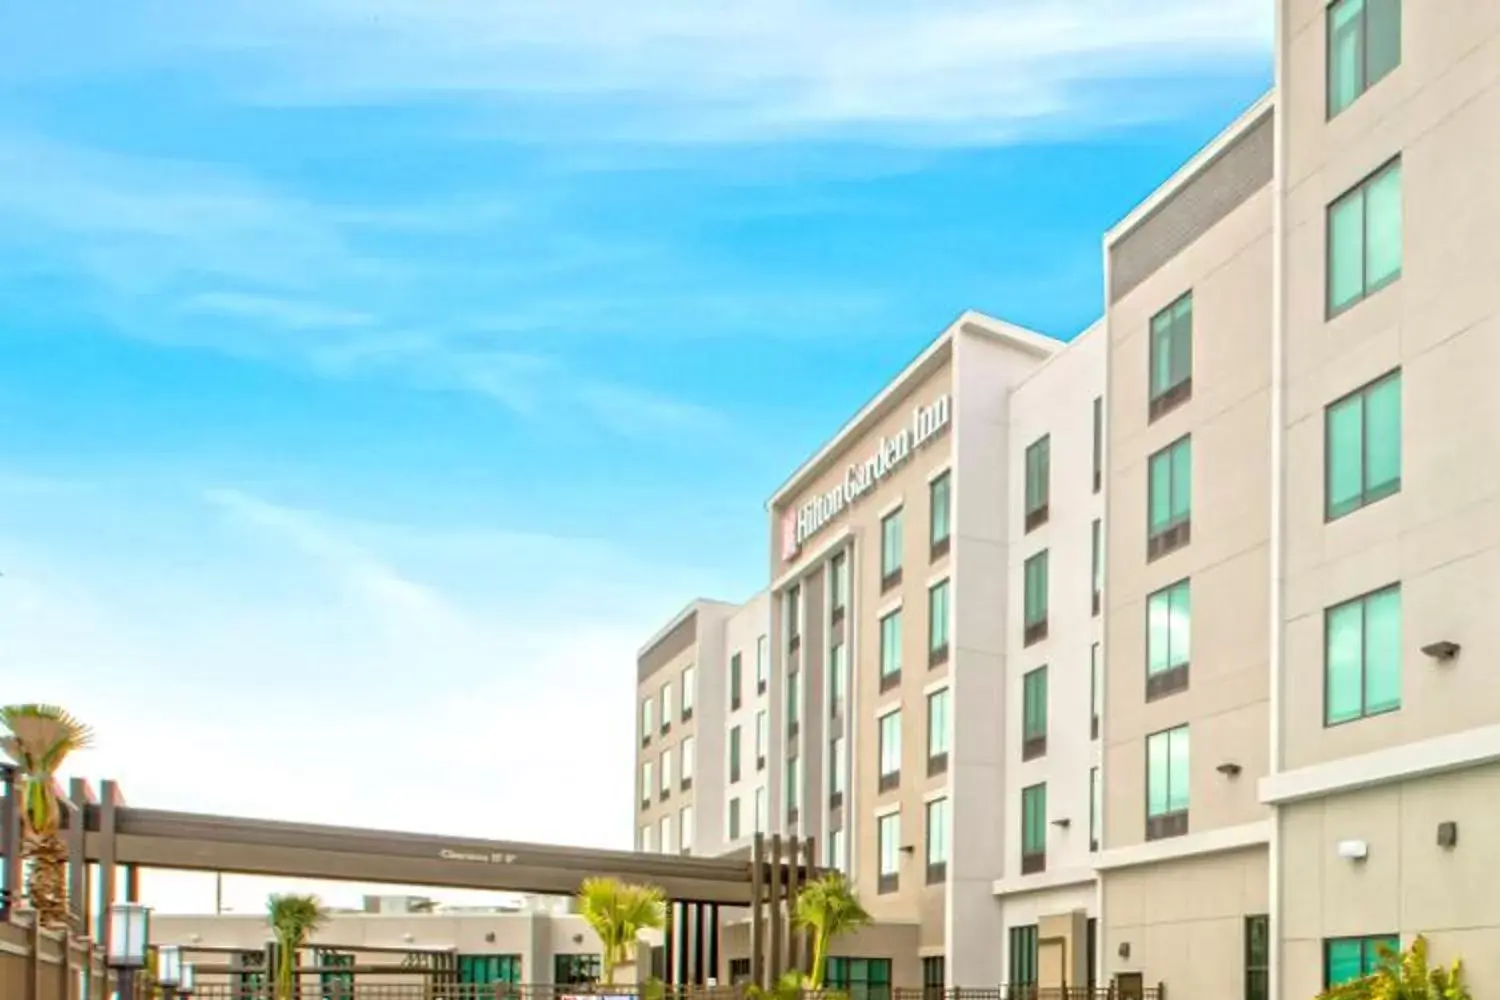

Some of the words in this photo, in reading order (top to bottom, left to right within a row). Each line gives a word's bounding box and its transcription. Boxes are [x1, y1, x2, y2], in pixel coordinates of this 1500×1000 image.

[796, 482, 843, 544] Hilton
[843, 427, 909, 503] Garden
[911, 394, 949, 449] Inn
